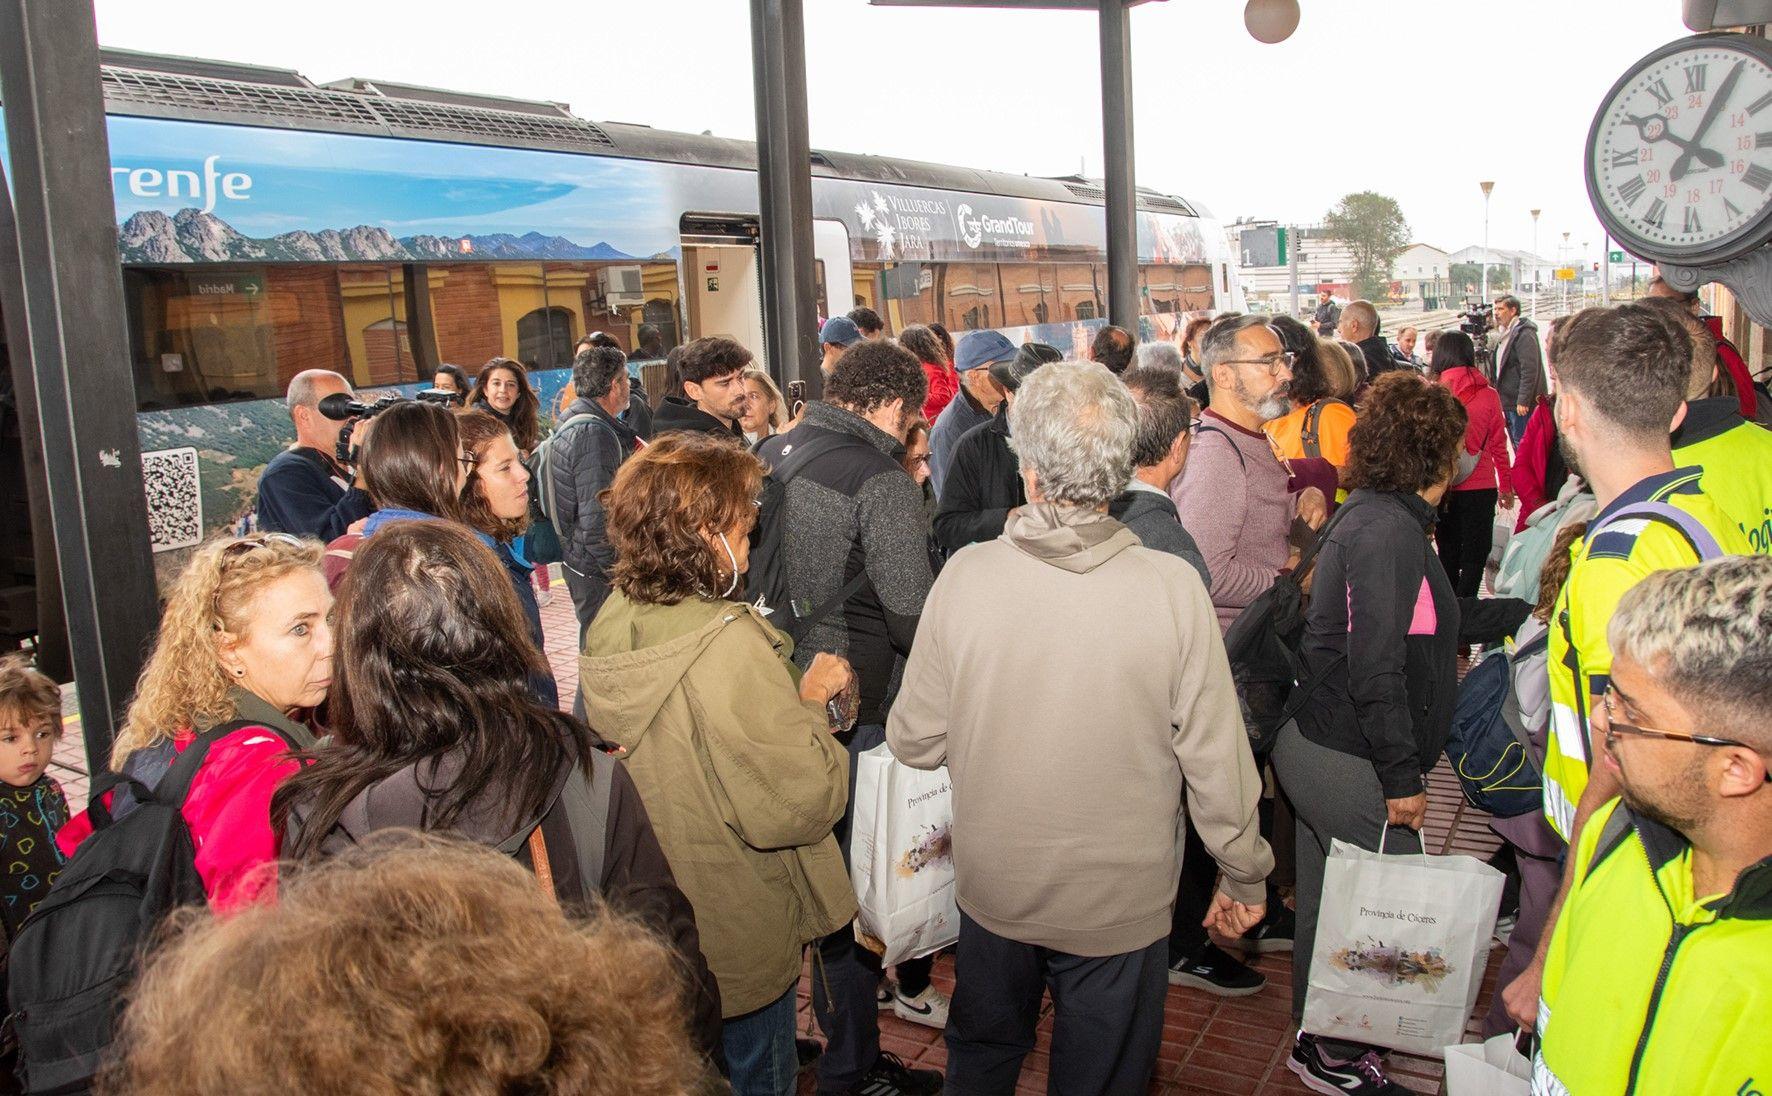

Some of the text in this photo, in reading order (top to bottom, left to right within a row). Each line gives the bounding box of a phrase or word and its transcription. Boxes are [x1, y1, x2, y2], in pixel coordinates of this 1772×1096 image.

[1684, 64, 1708, 95] XII
[1645, 77, 1674, 110] XI
[1687, 95, 1702, 109] 24
[1665, 105, 1679, 120] 23
[1730, 113, 1745, 128] 14
[1648, 123, 1663, 138] 22
[1737, 136, 1751, 150] 15
[1640, 148, 1654, 162] 21
[1729, 159, 1745, 174] 16
[1647, 169, 1661, 184] 20
[1663, 183, 1677, 198] 19
[1709, 178, 1724, 194] 17
[1687, 188, 1701, 203] 18
[896, 213, 931, 231] IBORES
[1682, 206, 1703, 233] VI
[900, 232, 924, 254] JARA
[1242, 248, 1254, 266] 1
[939, 782, 948, 793] de
[1396, 909, 1406, 920] de
